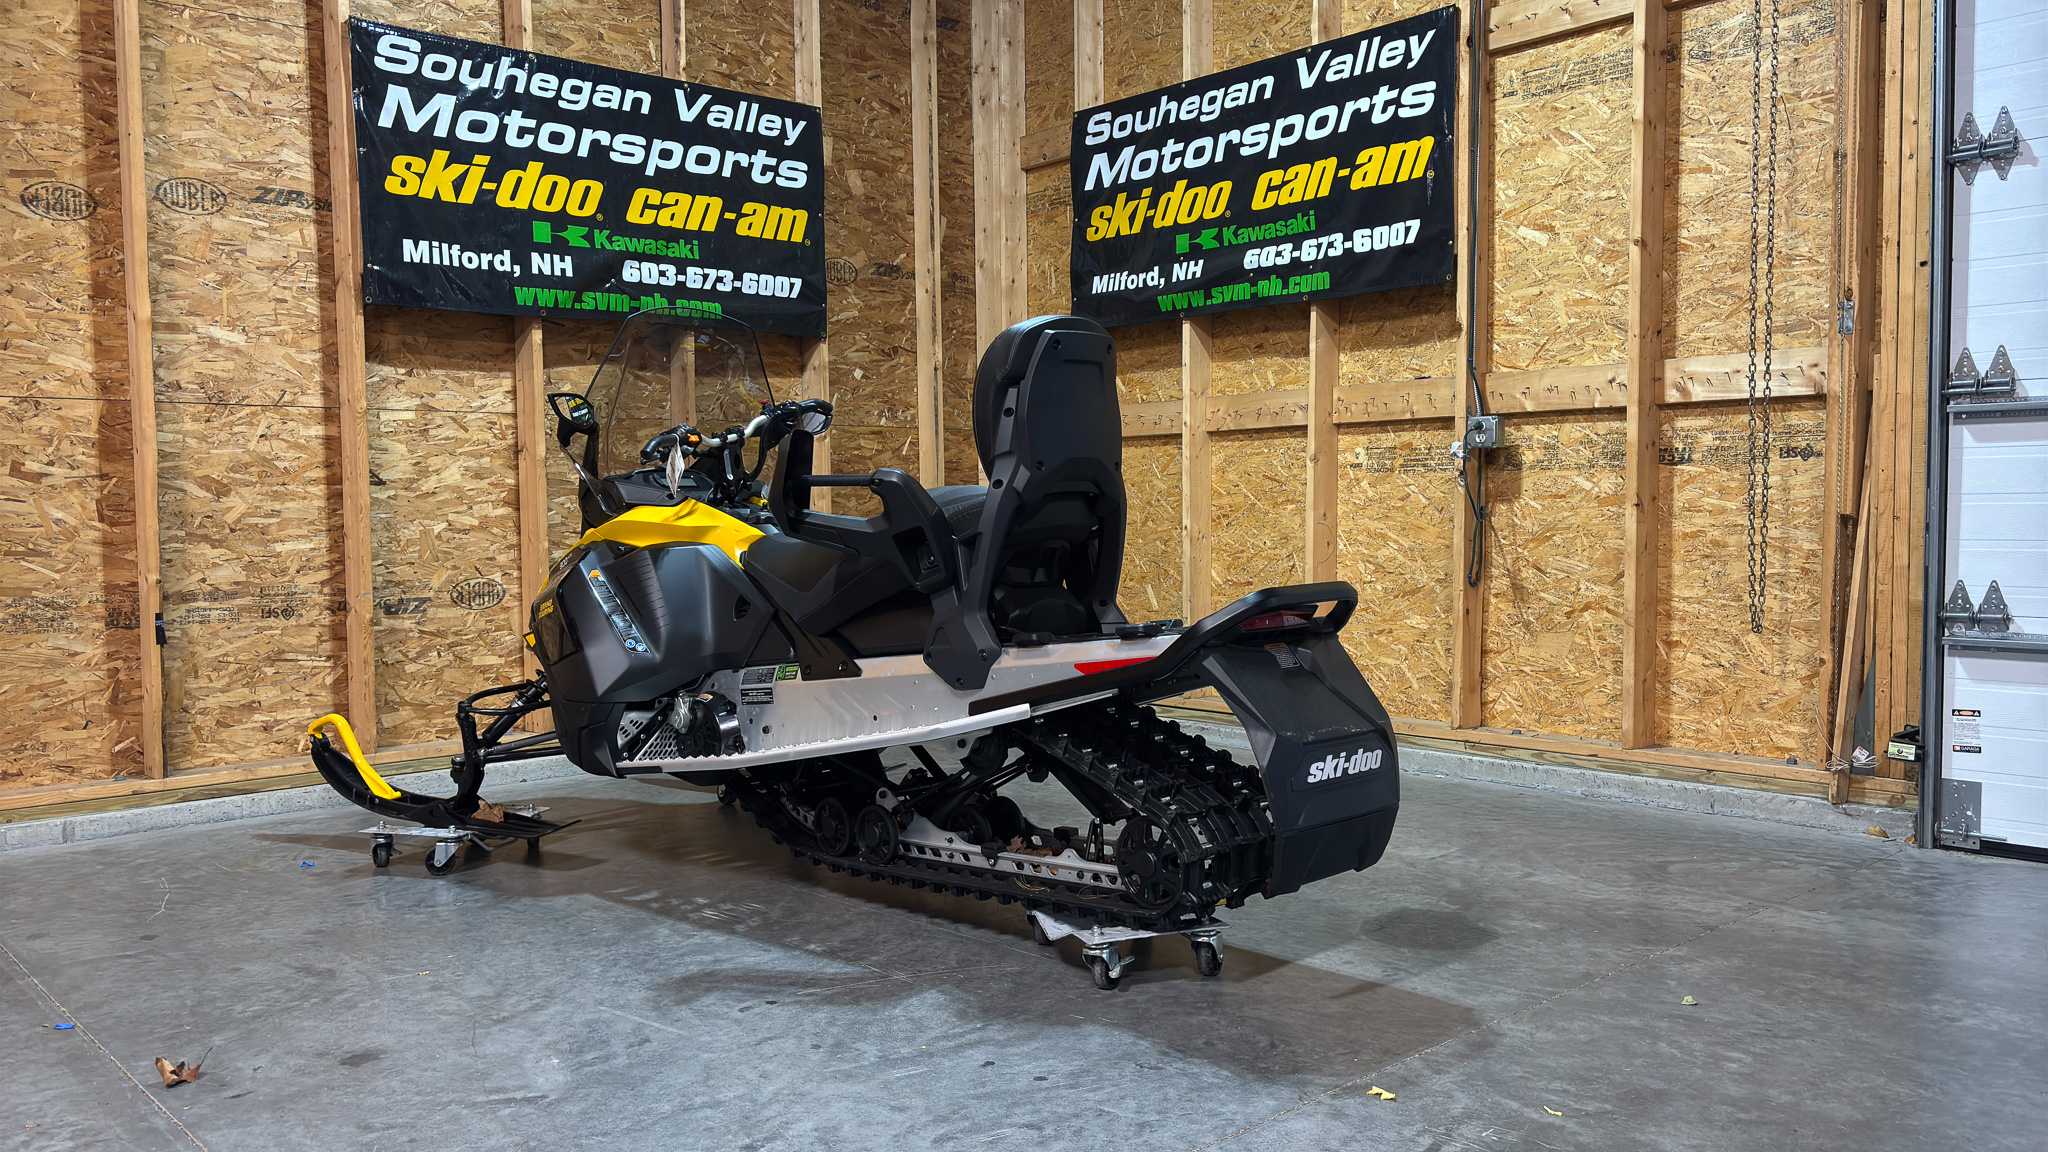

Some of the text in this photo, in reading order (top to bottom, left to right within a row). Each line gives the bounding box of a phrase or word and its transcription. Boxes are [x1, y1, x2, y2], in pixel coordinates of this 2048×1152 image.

[374, 32, 807, 146] Souhegan Valley
[1085, 29, 1437, 146] Souhegan Valley
[378, 84, 808, 189] Motorsports
[1084, 81, 1437, 191] Motorsports
[385, 150, 809, 243] ski-doo can-am
[1086, 180, 1233, 242] ski-doo
[1251, 136, 1435, 211] can-am
[593, 229, 701, 260] Kawasaki
[1222, 210, 1316, 247] Kawasaki
[1243, 219, 1421, 270] 603-673-6007
[402, 238, 574, 278] Milford, NH
[1091, 258, 1205, 295] Milford, NH
[621, 259, 803, 299] 603-673-6007
[1157, 271, 1331, 312] www.svm-nh.com
[513, 286, 723, 319] www.svm-nh.com
[1306, 748, 1383, 783] ski-doo
